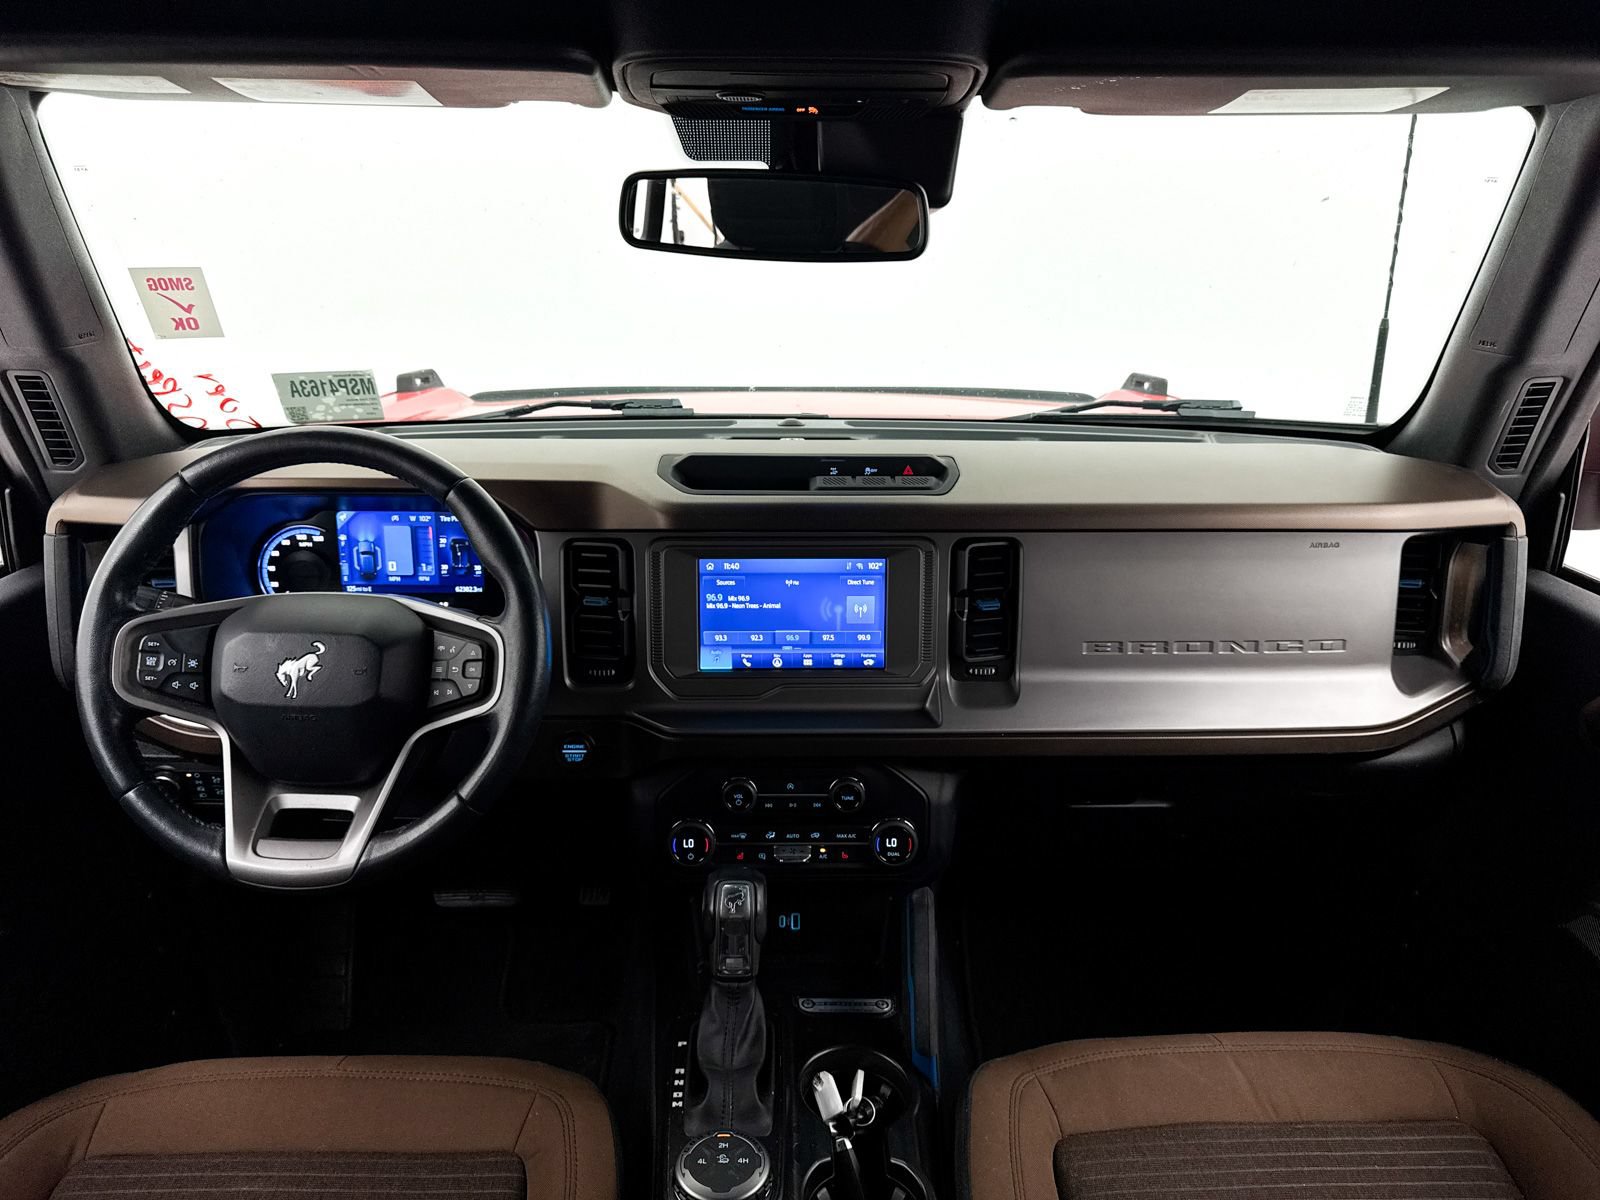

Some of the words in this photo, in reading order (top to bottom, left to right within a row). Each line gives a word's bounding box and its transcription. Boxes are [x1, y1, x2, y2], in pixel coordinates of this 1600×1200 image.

[388, 561, 396, 571] 0
[724, 562, 740, 570] 11:40
[706, 593, 723, 601] 96.9
[1081, 639, 1347, 655] BRONCO
[683, 839, 694, 848] LO
[886, 838, 897, 847] LO
